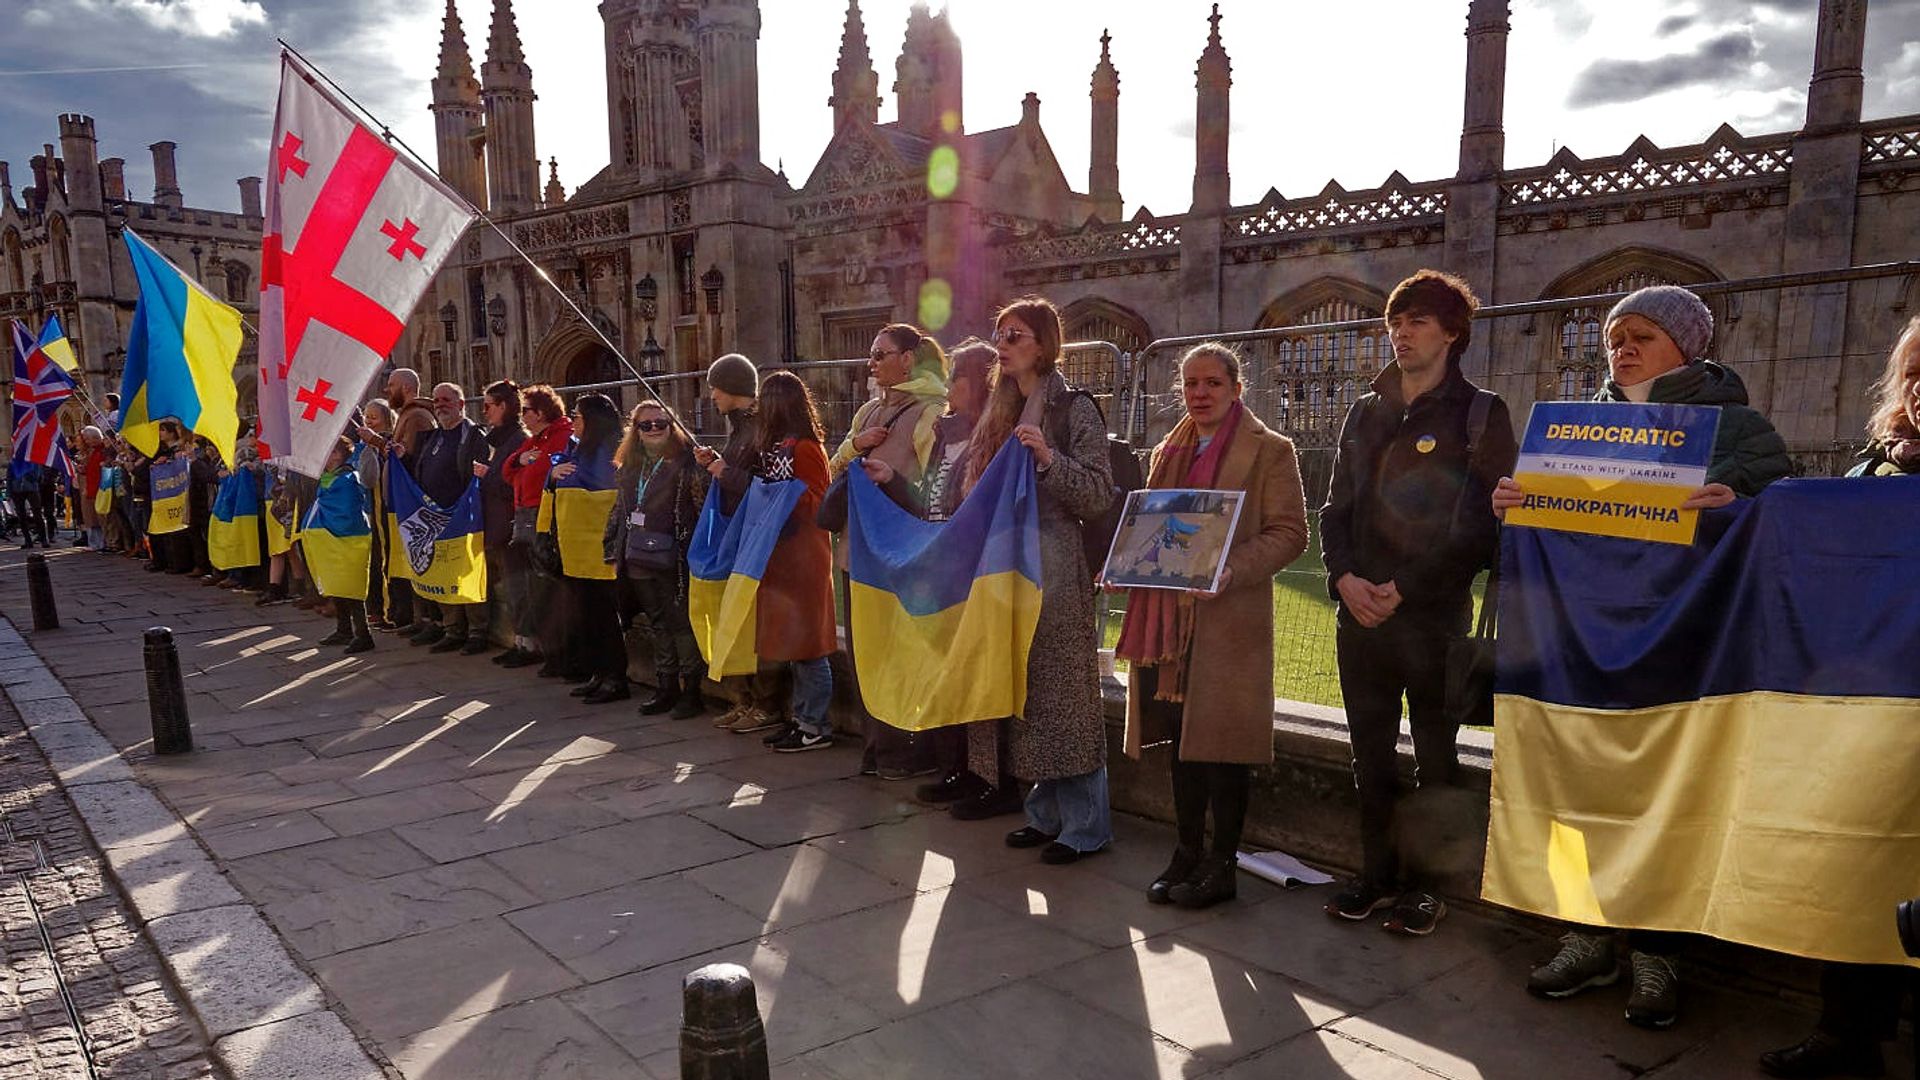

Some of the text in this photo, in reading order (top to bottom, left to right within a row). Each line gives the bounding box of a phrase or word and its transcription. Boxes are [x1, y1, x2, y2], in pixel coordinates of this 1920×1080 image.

[1545, 423, 1686, 447] DEMOCRATIC
[1562, 463, 1594, 472] STAND
[1600, 465, 1625, 475] WITH
[1629, 468, 1678, 480] UKRAINE
[1521, 493, 1680, 523] ДЕМОКРАТИЧНА
